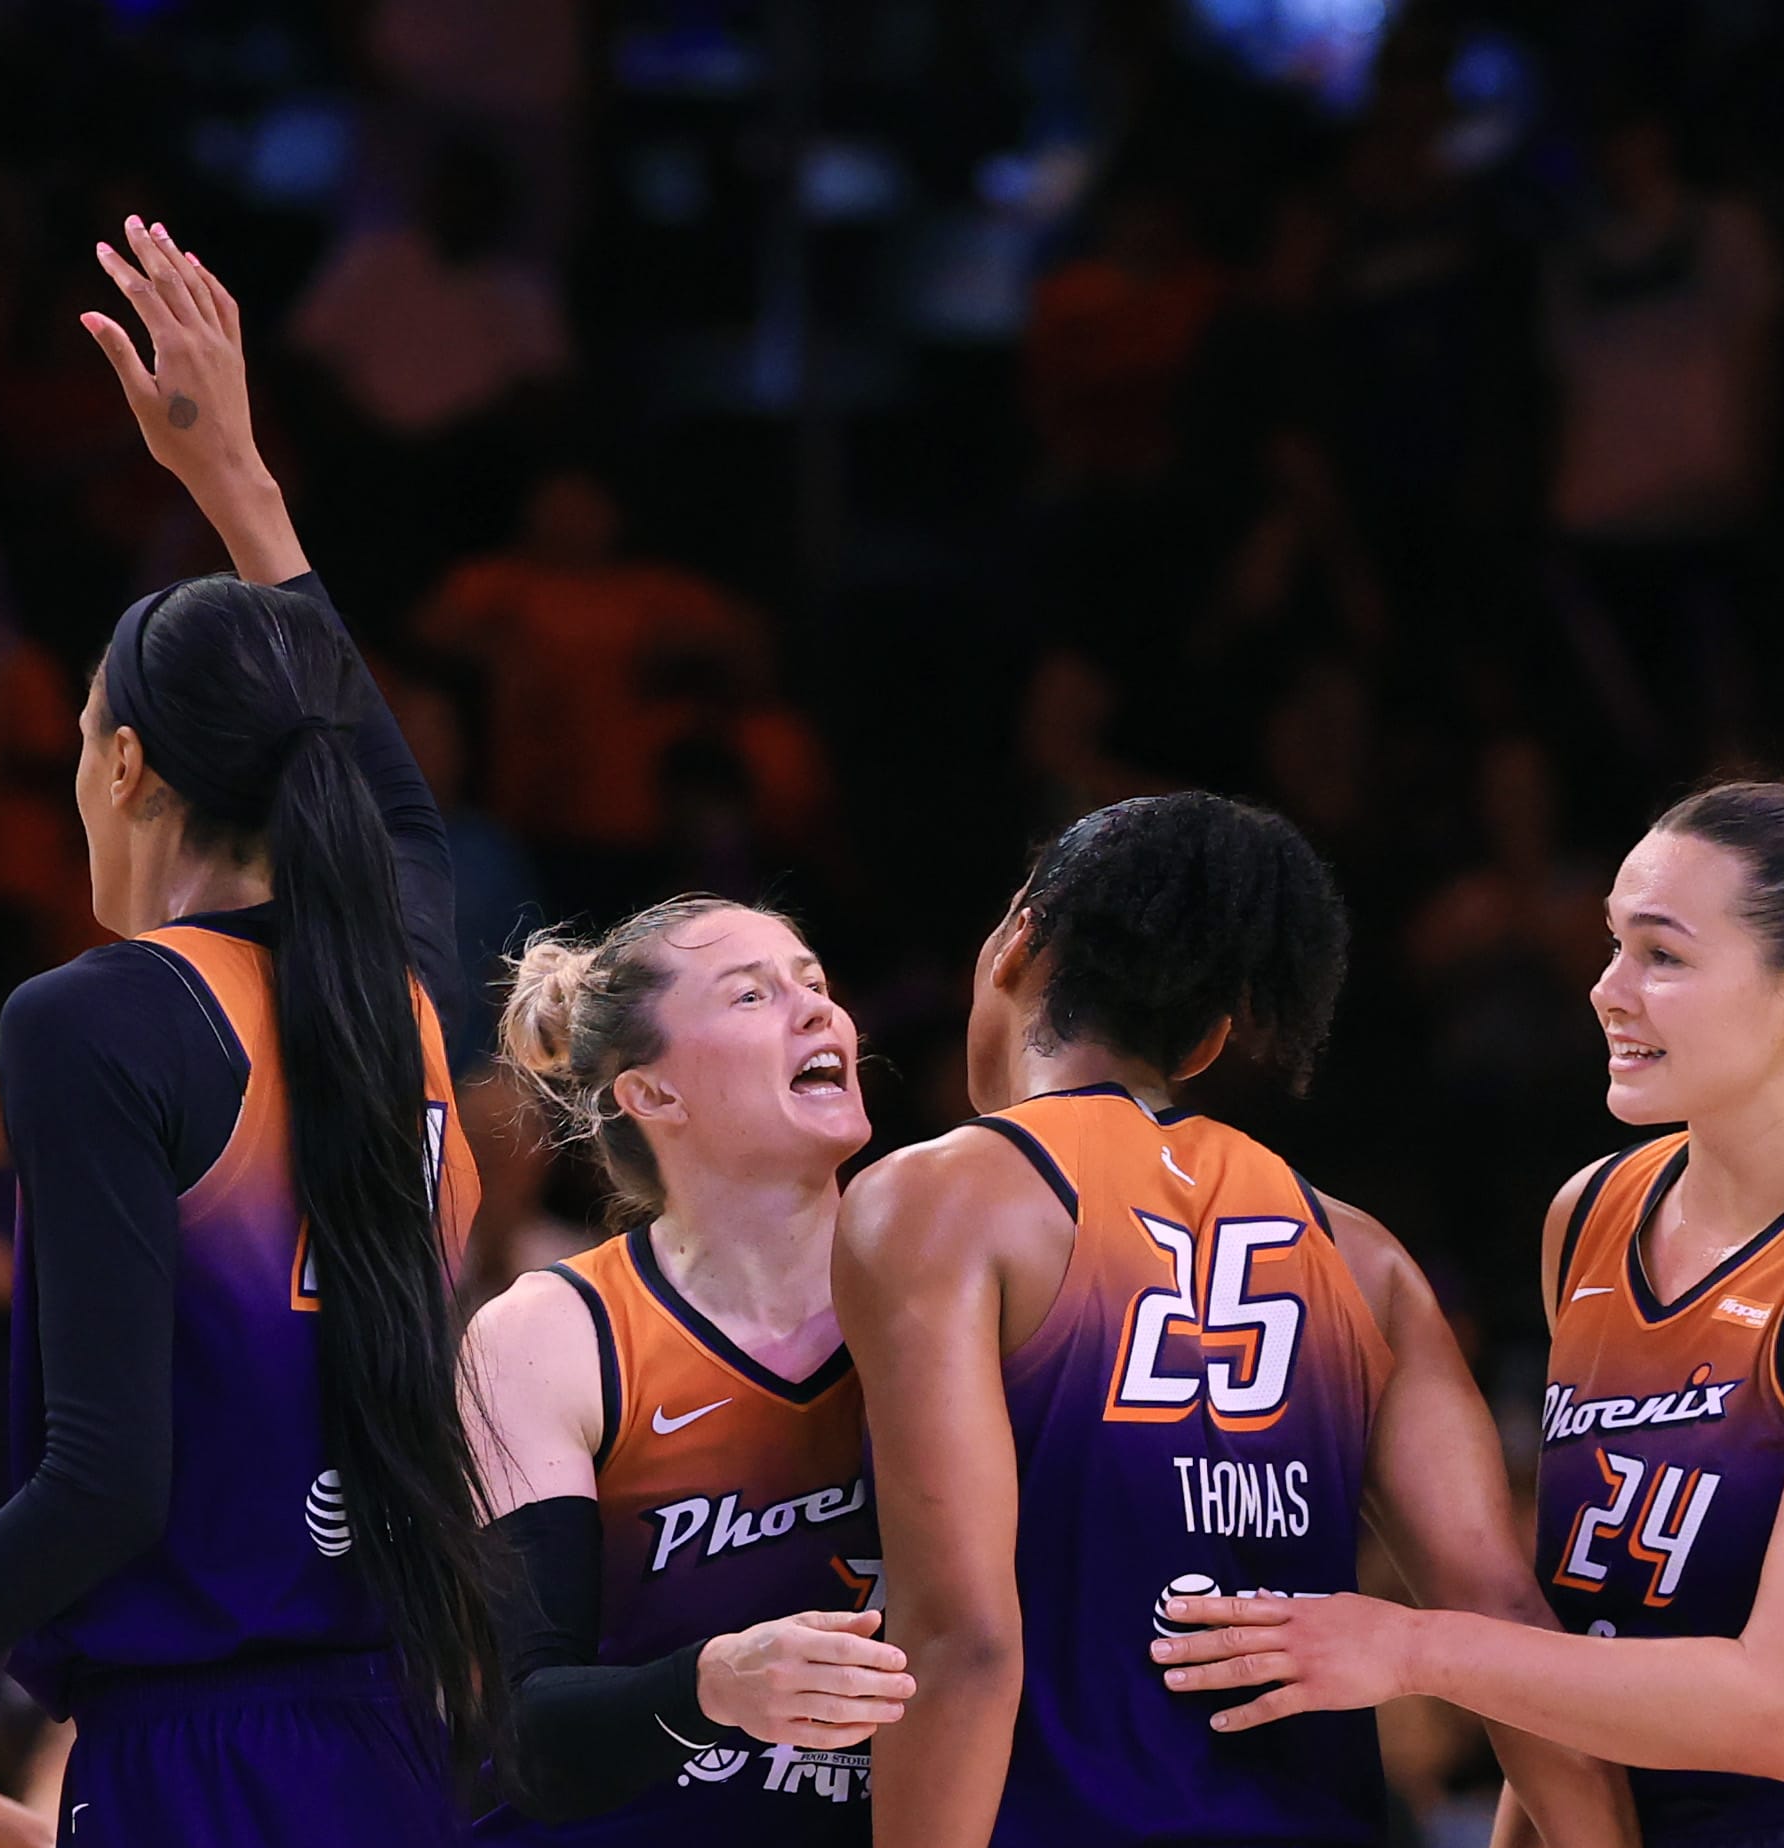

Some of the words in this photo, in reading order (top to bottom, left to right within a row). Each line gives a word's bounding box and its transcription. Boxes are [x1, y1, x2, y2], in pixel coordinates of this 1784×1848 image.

[1104, 1208, 1308, 1431] 25
[1541, 1363, 1744, 1442] Phoenix
[1172, 1456, 1310, 1538] THOMAS
[1552, 1448, 1722, 1608] 24
